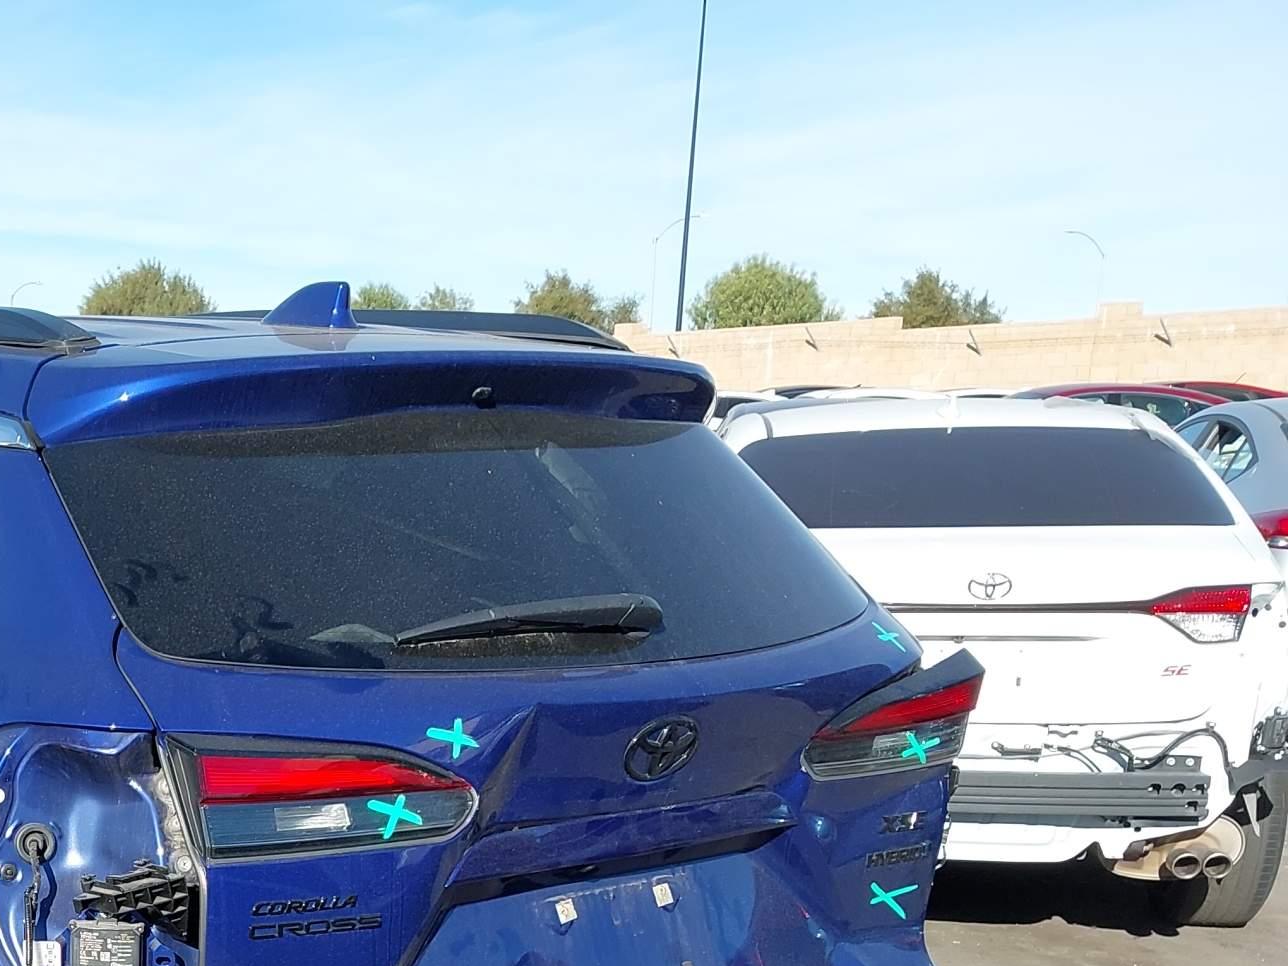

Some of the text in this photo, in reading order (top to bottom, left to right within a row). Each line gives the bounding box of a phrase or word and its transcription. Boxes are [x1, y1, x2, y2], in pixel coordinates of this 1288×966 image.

[1160, 664, 1192, 676] SE
[252, 895, 357, 915] COROLLA
[249, 913, 382, 940] CROSS
